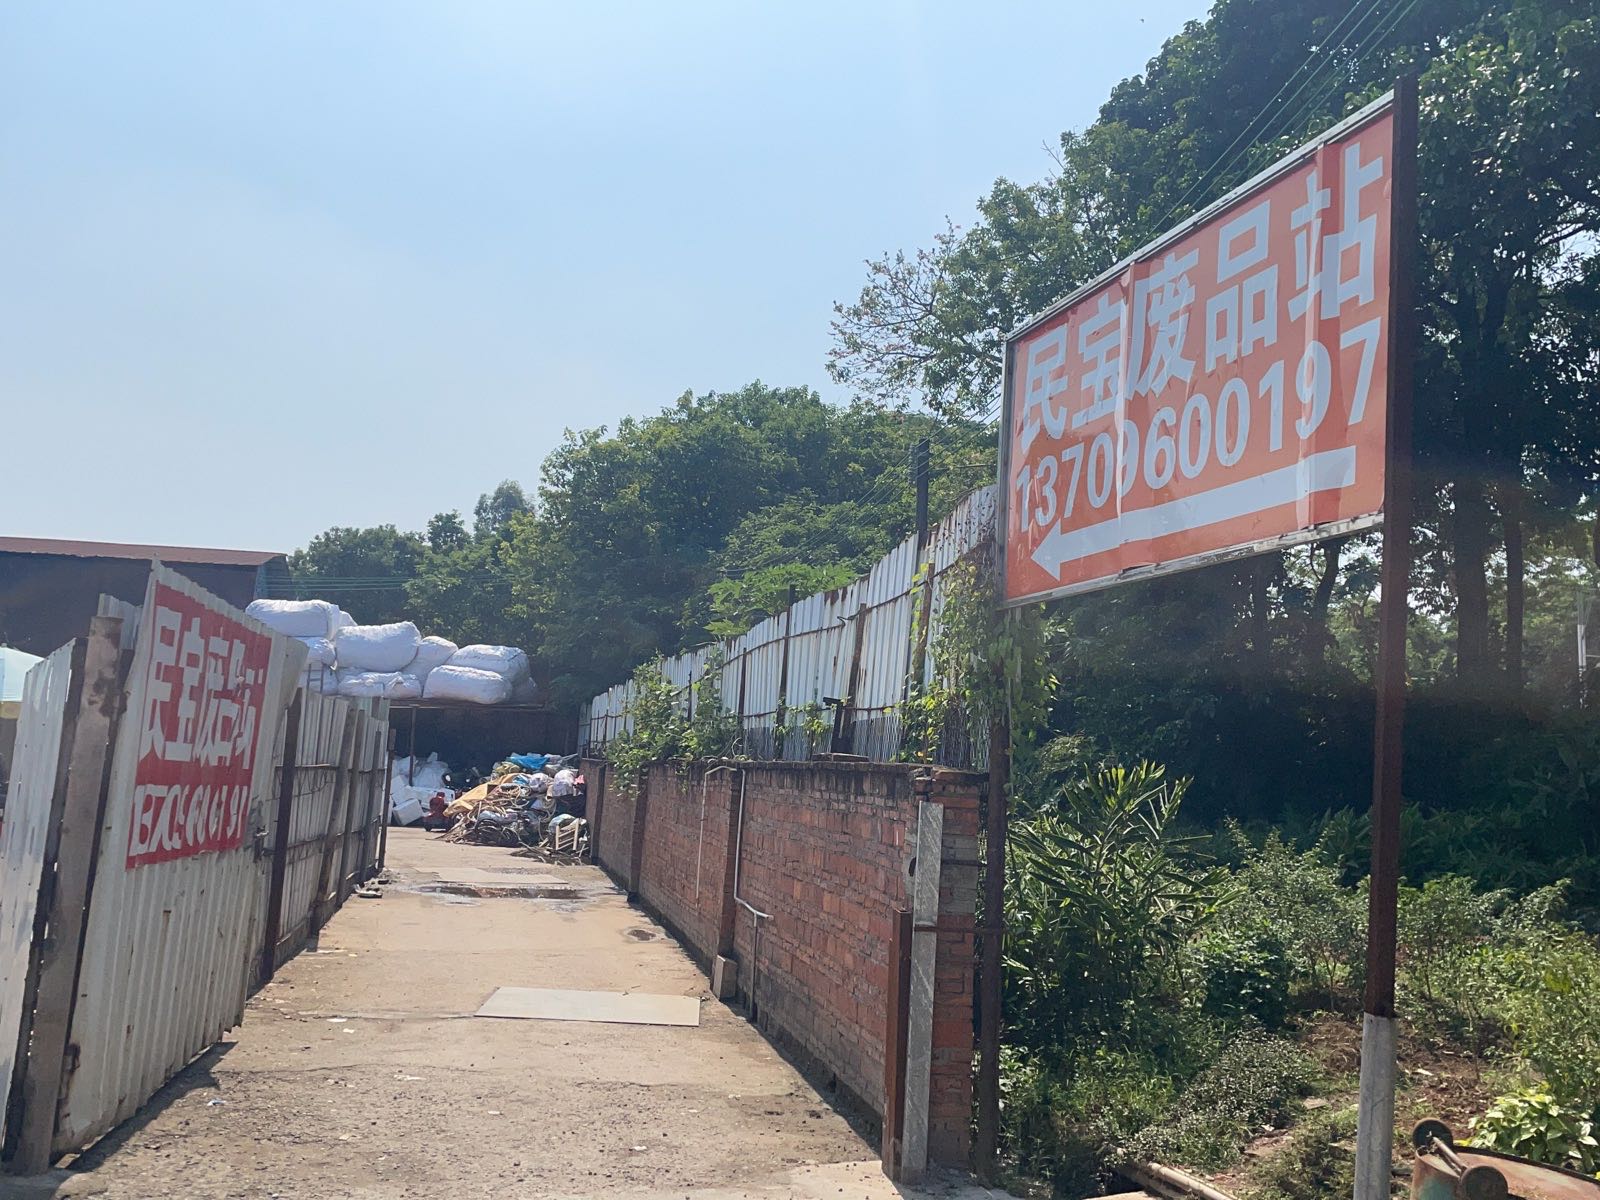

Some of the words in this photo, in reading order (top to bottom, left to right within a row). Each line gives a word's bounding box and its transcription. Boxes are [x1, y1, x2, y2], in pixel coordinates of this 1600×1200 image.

[1016, 317, 1380, 532] 13709600197
[1020, 142, 1383, 456] 民宝废品站
